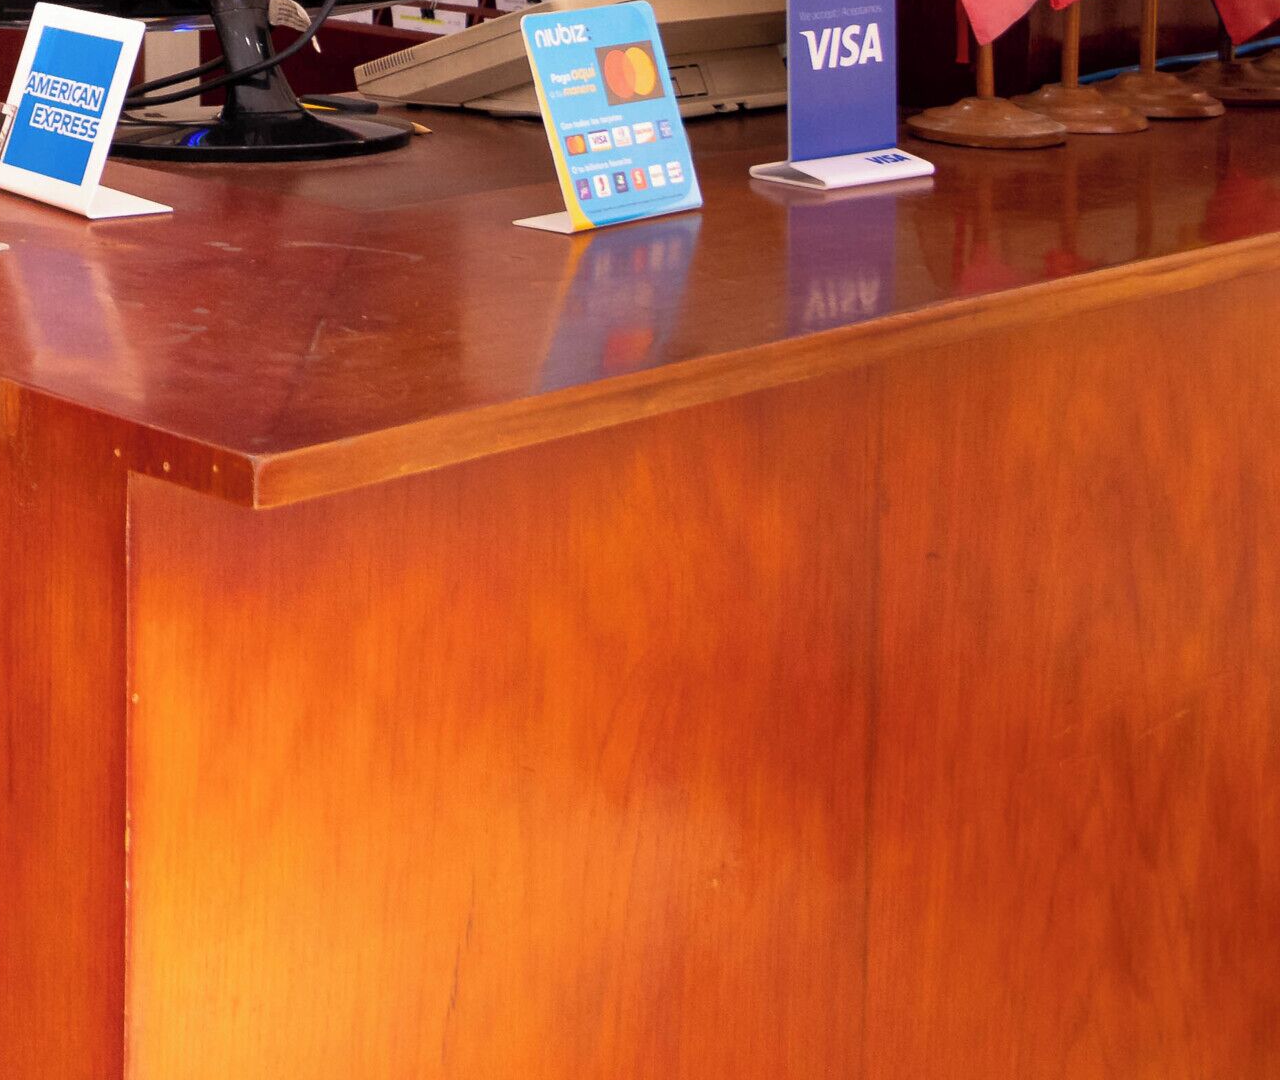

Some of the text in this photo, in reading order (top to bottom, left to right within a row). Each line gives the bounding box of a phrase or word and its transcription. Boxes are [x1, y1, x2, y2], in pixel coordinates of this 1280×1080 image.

[799, 22, 883, 70] VISA
[26, 73, 102, 110] AMERICAN
[33, 106, 99, 140] EXPRESS
[592, 135, 608, 145] VISA
[865, 153, 911, 165] VISA
